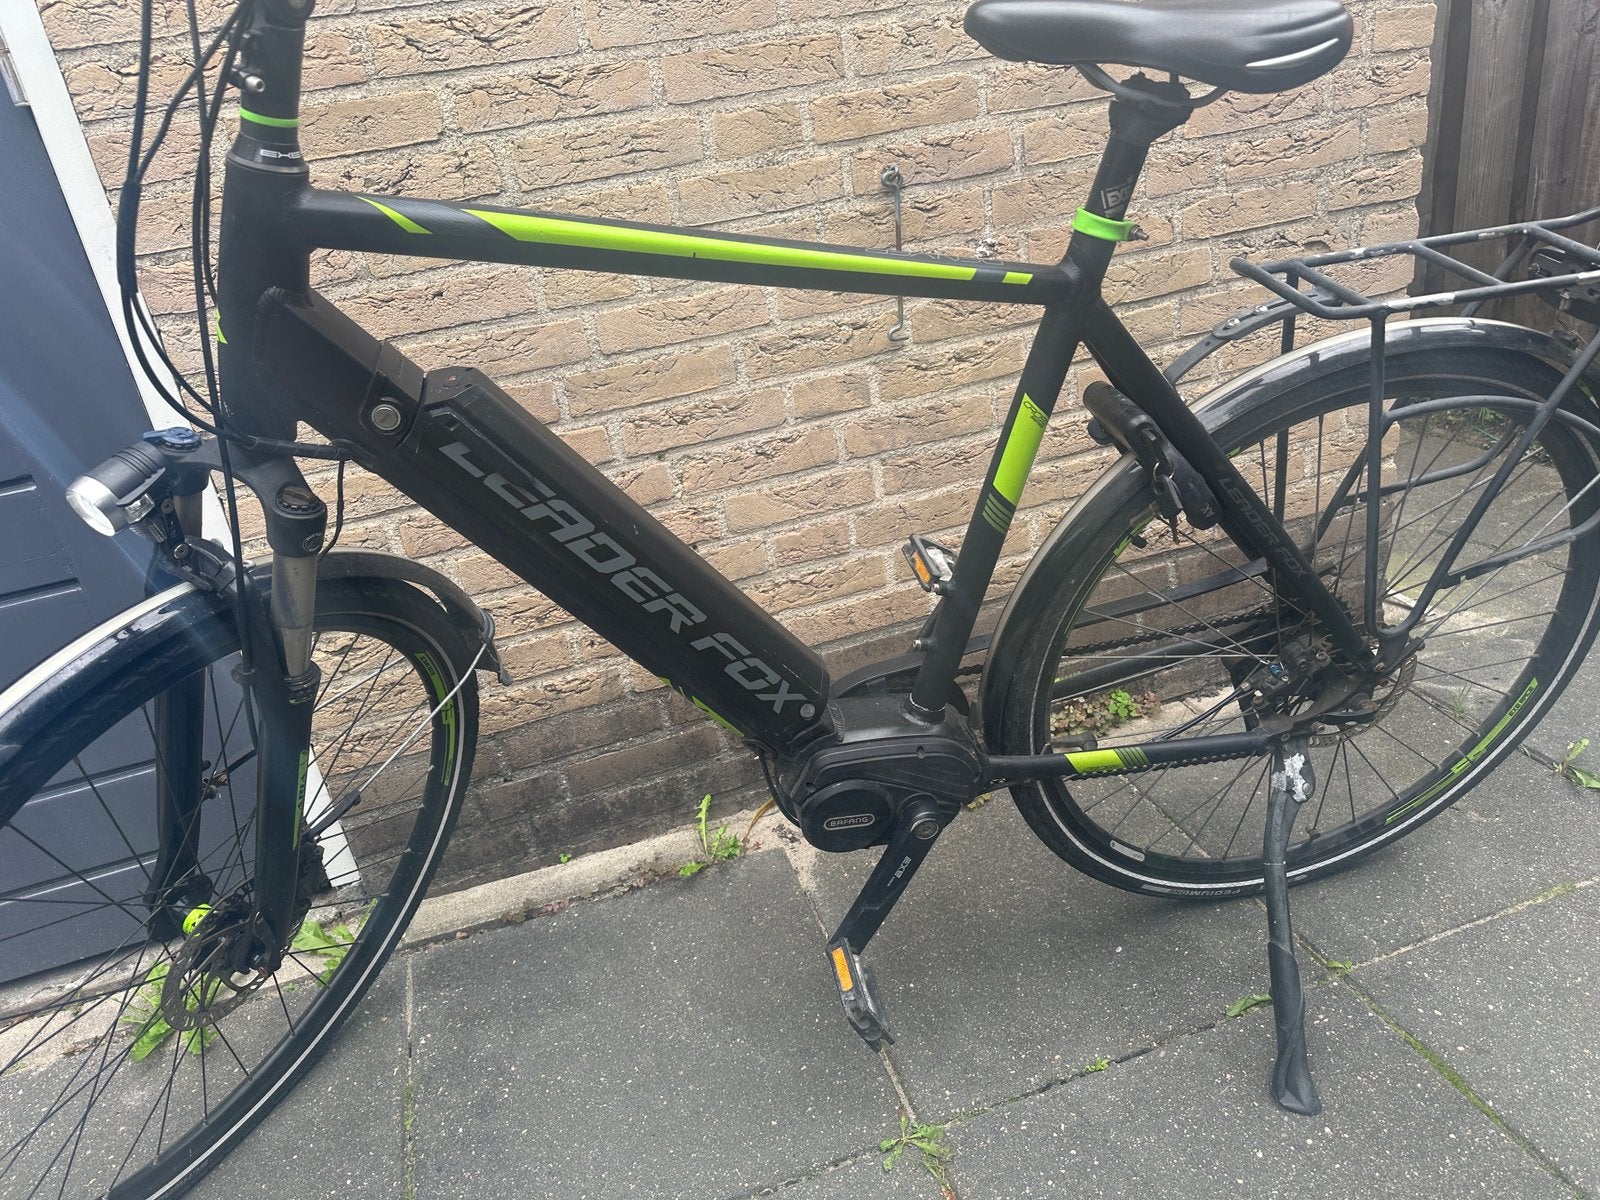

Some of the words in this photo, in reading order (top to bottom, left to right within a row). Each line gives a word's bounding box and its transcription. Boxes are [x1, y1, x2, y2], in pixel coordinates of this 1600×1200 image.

[1219, 478, 1280, 545] LEADER
[1274, 547, 1308, 577] FOX
[438, 441, 707, 634] LEADER
[691, 632, 806, 714] FOX
[829, 815, 869, 827] BAFANG
